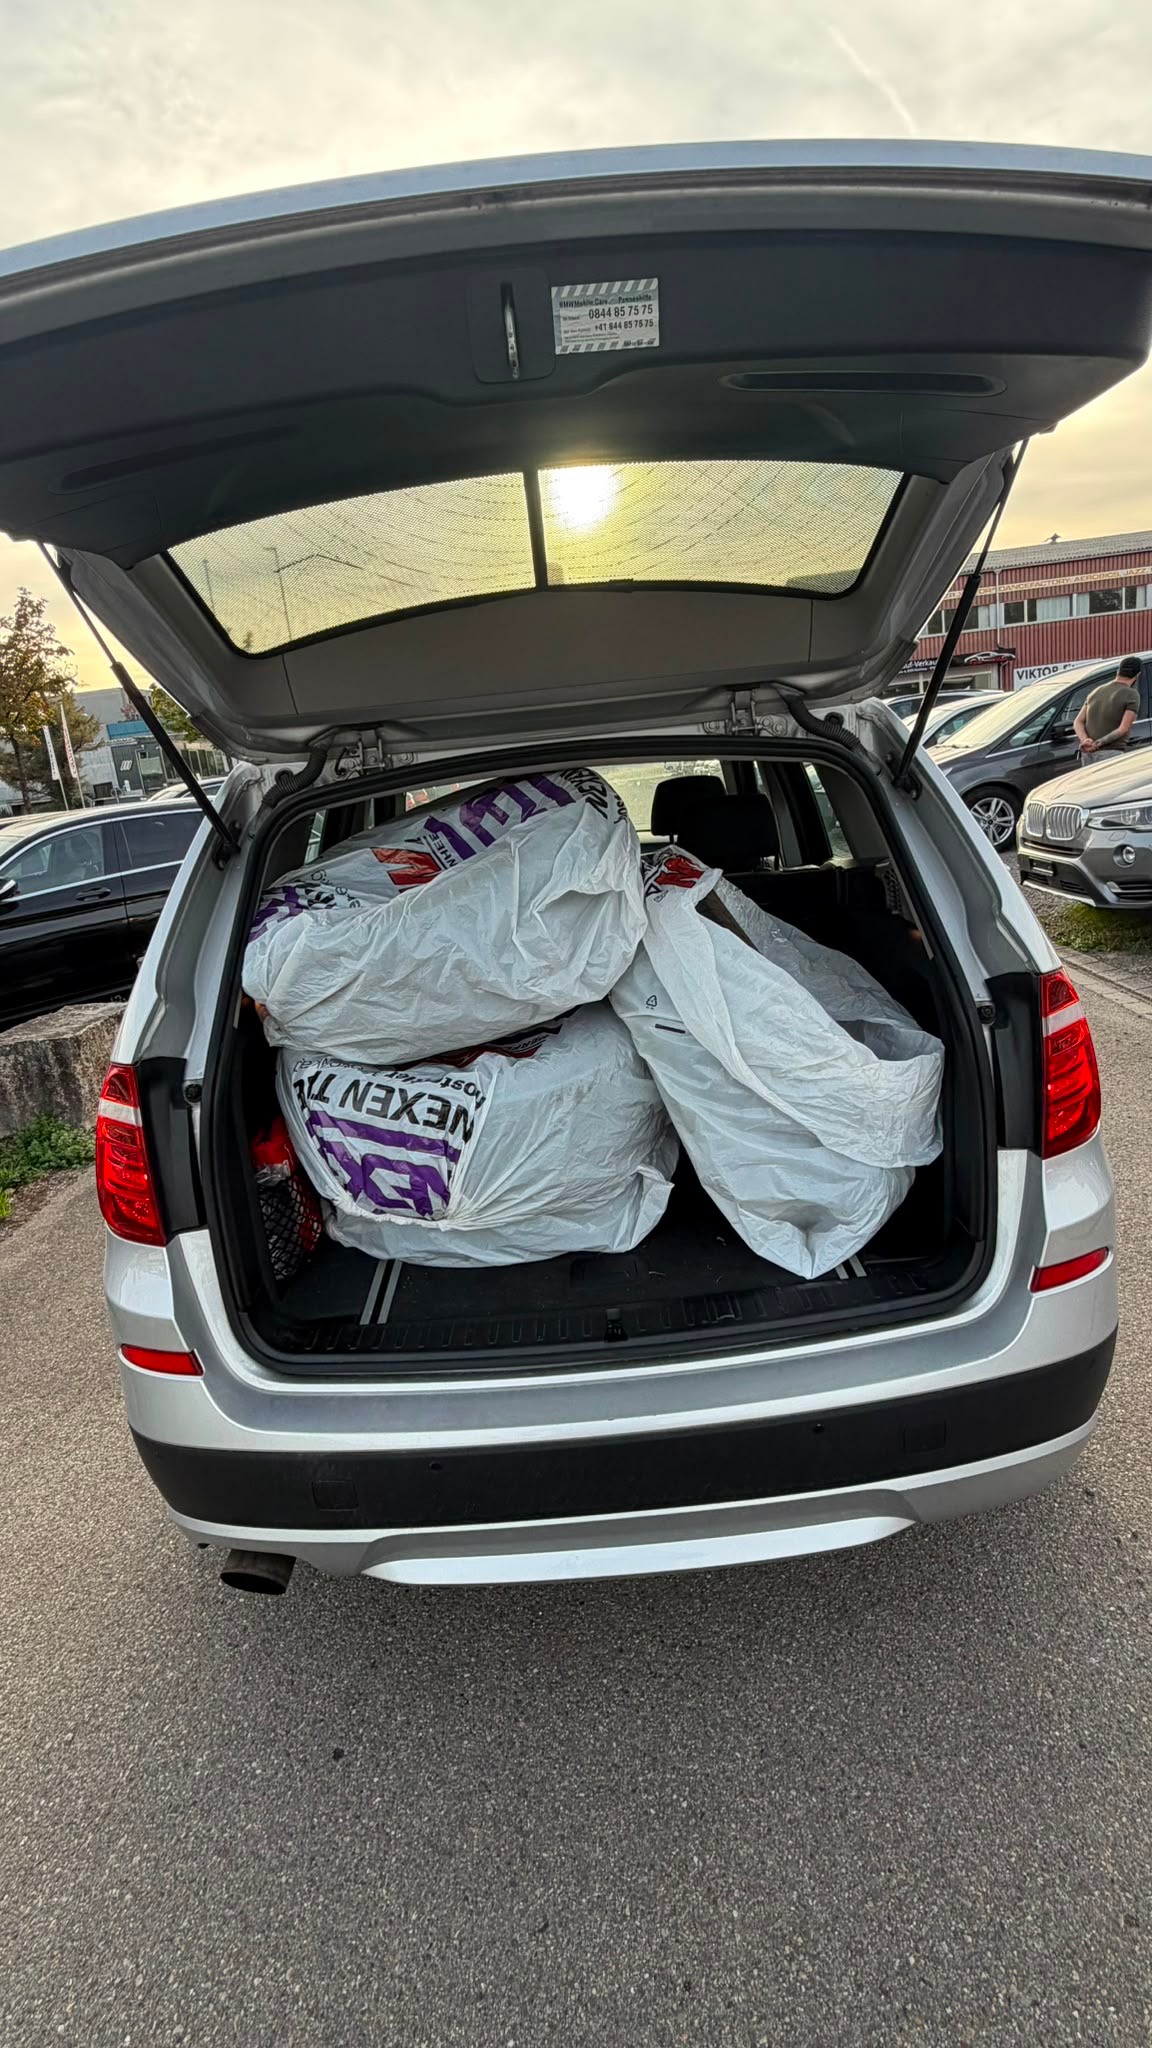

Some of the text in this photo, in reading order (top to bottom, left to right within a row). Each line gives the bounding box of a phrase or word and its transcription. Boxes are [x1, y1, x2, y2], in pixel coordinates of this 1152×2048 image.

[588, 306, 613, 320] 0844
[614, 306, 626, 317] 85
[628, 305, 640, 317] 75
[642, 304, 653, 315] 75
[595, 322, 607, 332] +41
[609, 320, 622, 331] 844
[624, 319, 633, 329] 85
[634, 319, 643, 329] 75
[645, 318, 654, 328] 75
[338, 1079, 476, 1144] NEXEN
